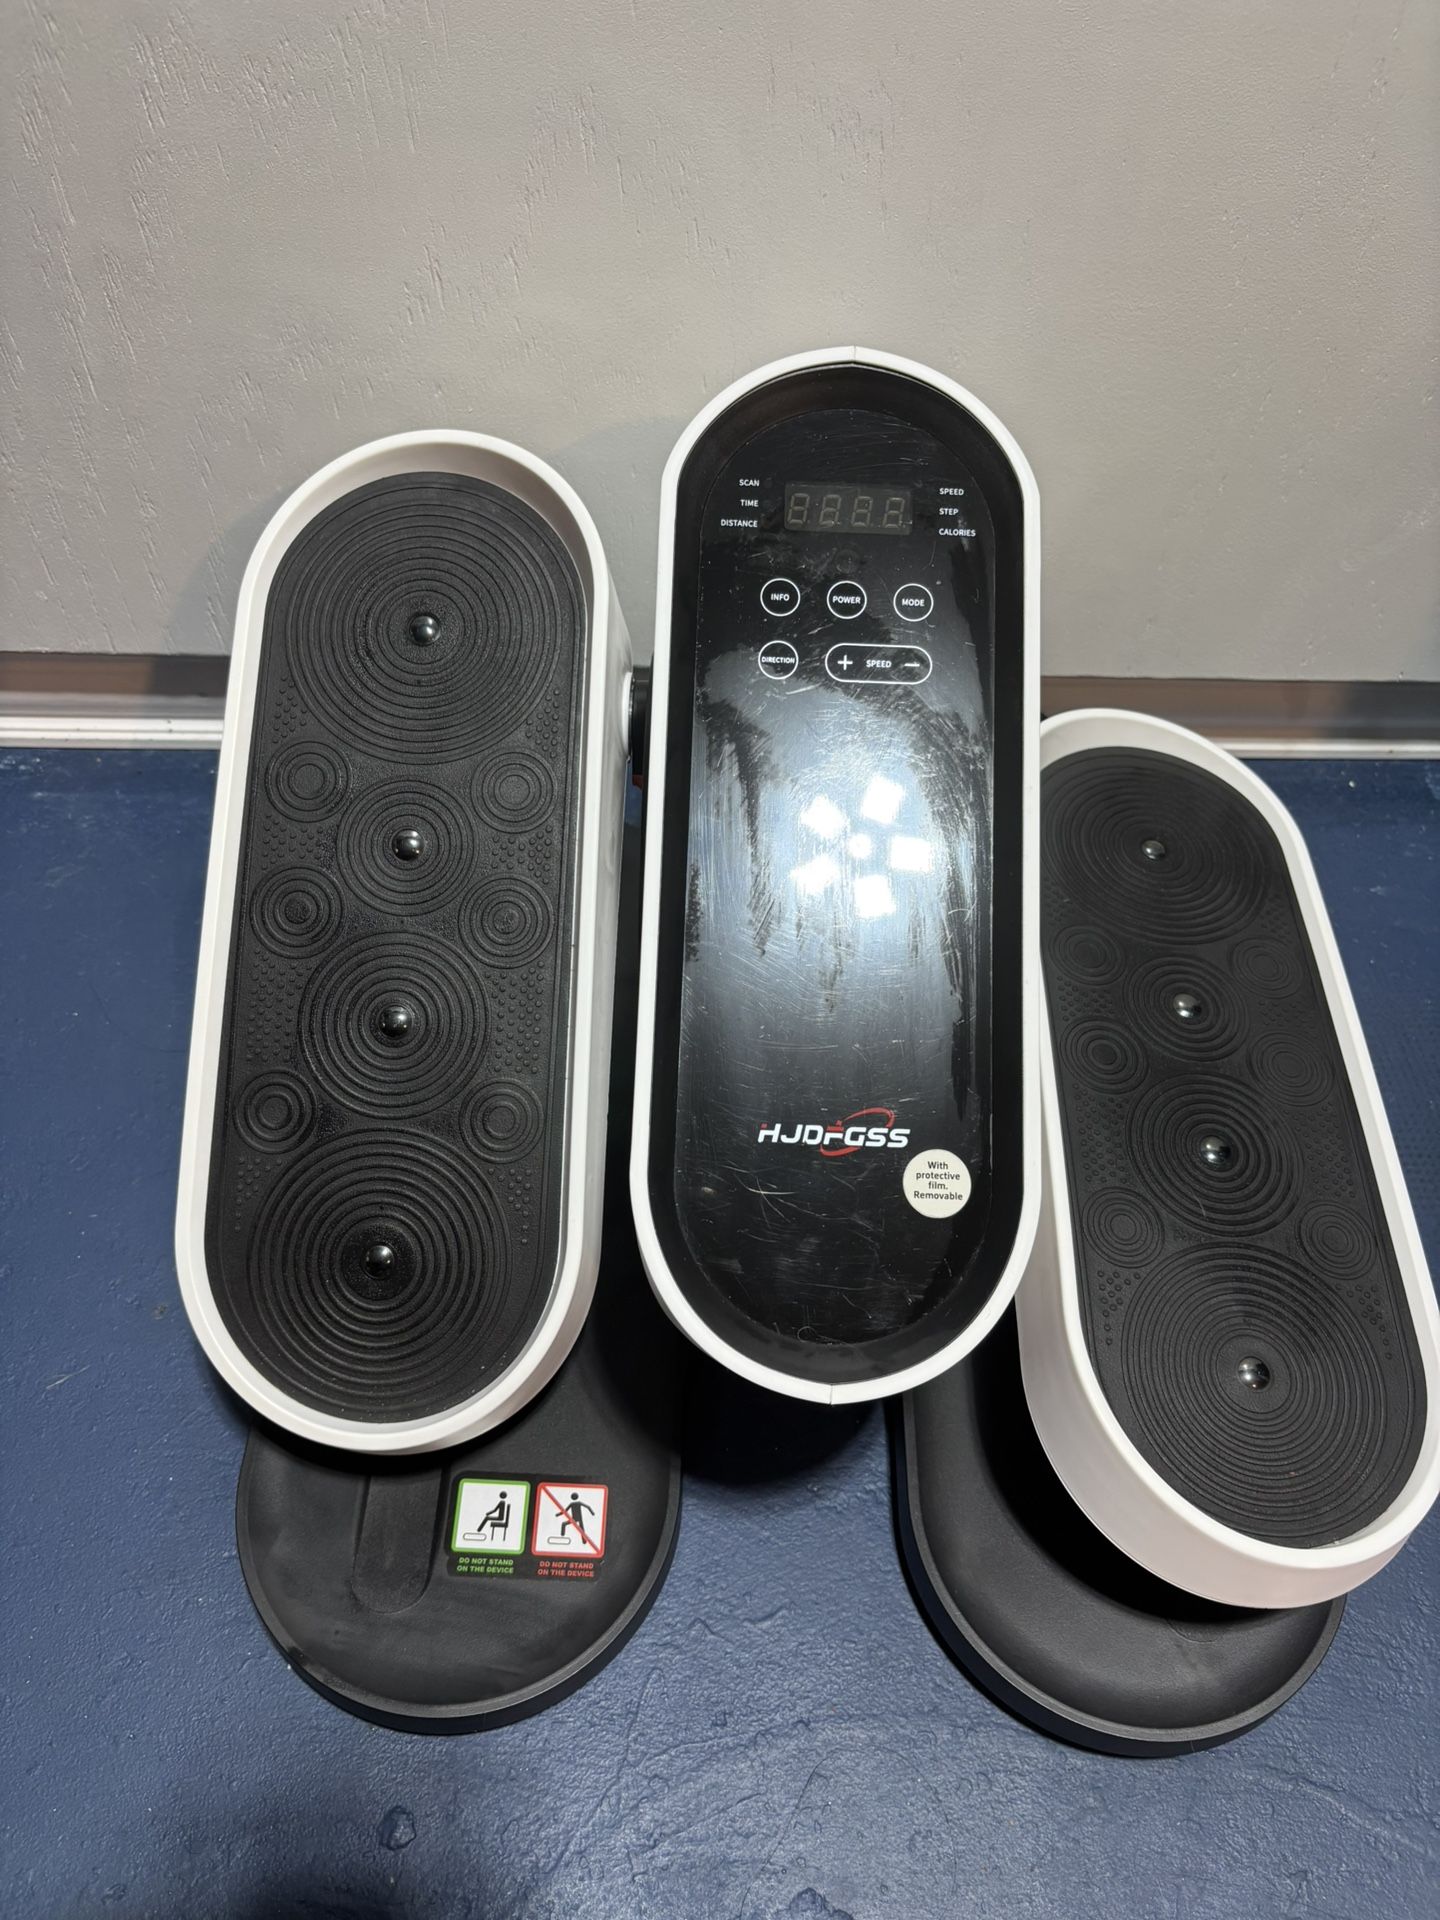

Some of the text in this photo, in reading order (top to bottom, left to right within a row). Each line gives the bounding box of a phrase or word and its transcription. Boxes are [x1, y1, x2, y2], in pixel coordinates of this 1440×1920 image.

[739, 479, 760, 487] SCAN
[939, 487, 965, 496] SPEED
[740, 499, 759, 507] TIME
[939, 507, 959, 516] STEP
[720, 519, 758, 528] DISTANCE
[938, 528, 976, 537] CALORIES
[770, 593, 790, 602] INFO
[832, 595, 861, 605] POWER
[902, 598, 925, 607] MODE
[761, 656, 795, 665] DIRECTION
[866, 659, 892, 669] SPEED
[927, 1160, 949, 1170] With
[915, 1171, 961, 1182] protective
[928, 1181, 949, 1190] film.
[913, 1190, 964, 1201] Removable
[472, 1557, 487, 1565] NOT
